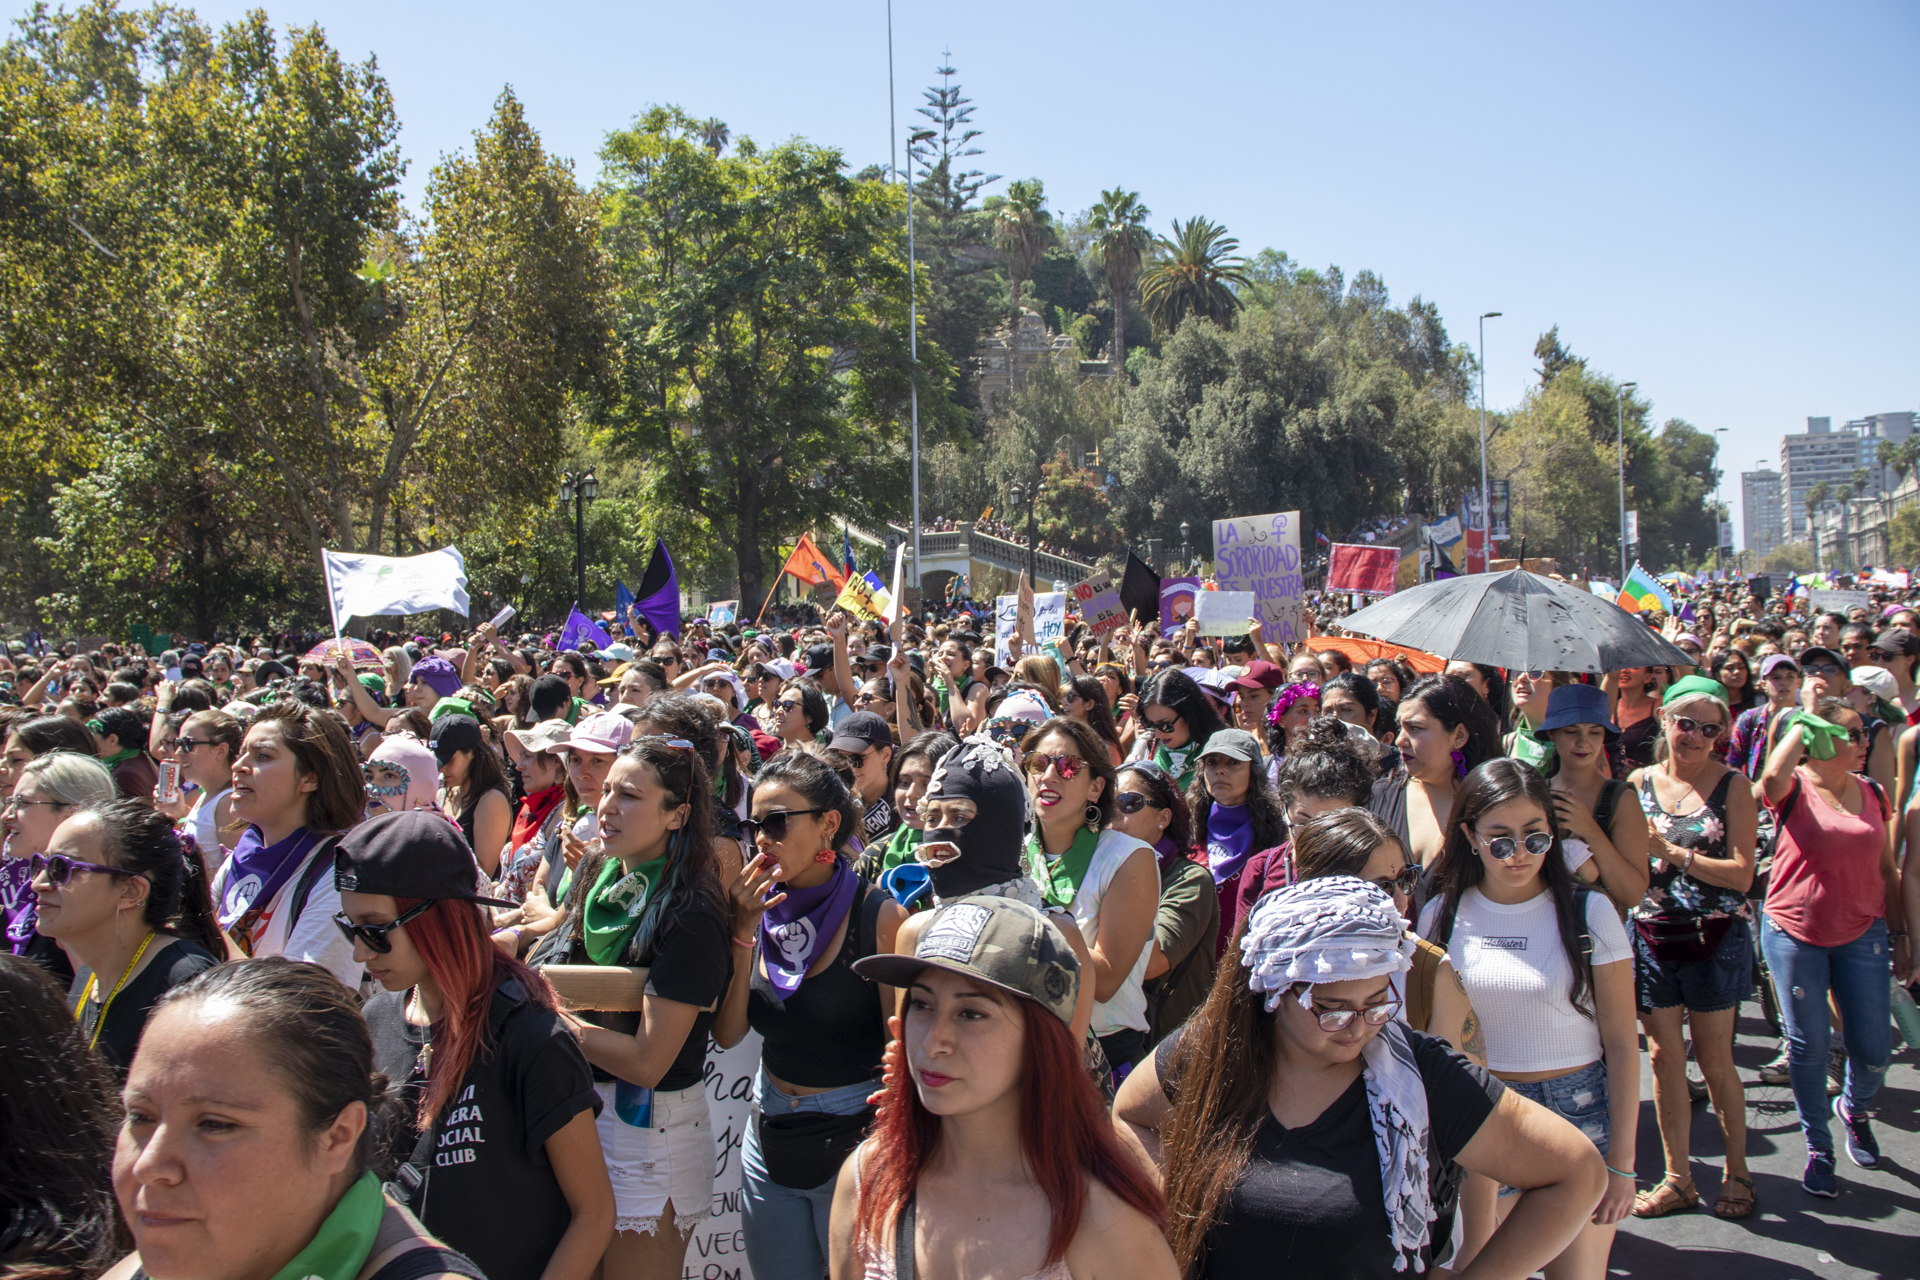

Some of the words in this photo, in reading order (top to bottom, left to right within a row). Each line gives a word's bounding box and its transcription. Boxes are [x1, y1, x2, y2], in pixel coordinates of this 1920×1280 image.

[1218, 522, 1239, 546] LA
[1216, 543, 1299, 580] SORORIDAD
[849, 576, 866, 595] NO
[1074, 583, 1093, 602] NO
[1093, 583, 1103, 593] ES
[1102, 580, 1112, 590] UN
[1251, 574, 1303, 601] NUESTRA
[1097, 612, 1106, 621] ES
[1105, 609, 1114, 618] EL
[1042, 621, 1061, 637] HOY
[1261, 620, 1296, 643] RMA
[925, 937, 969, 949] CHICAGO
[1483, 938, 1525, 949] Hollister
[437, 1126, 486, 1148] OCIAL
[435, 1147, 477, 1167] CLUB
[695, 1229, 746, 1258] VEG
